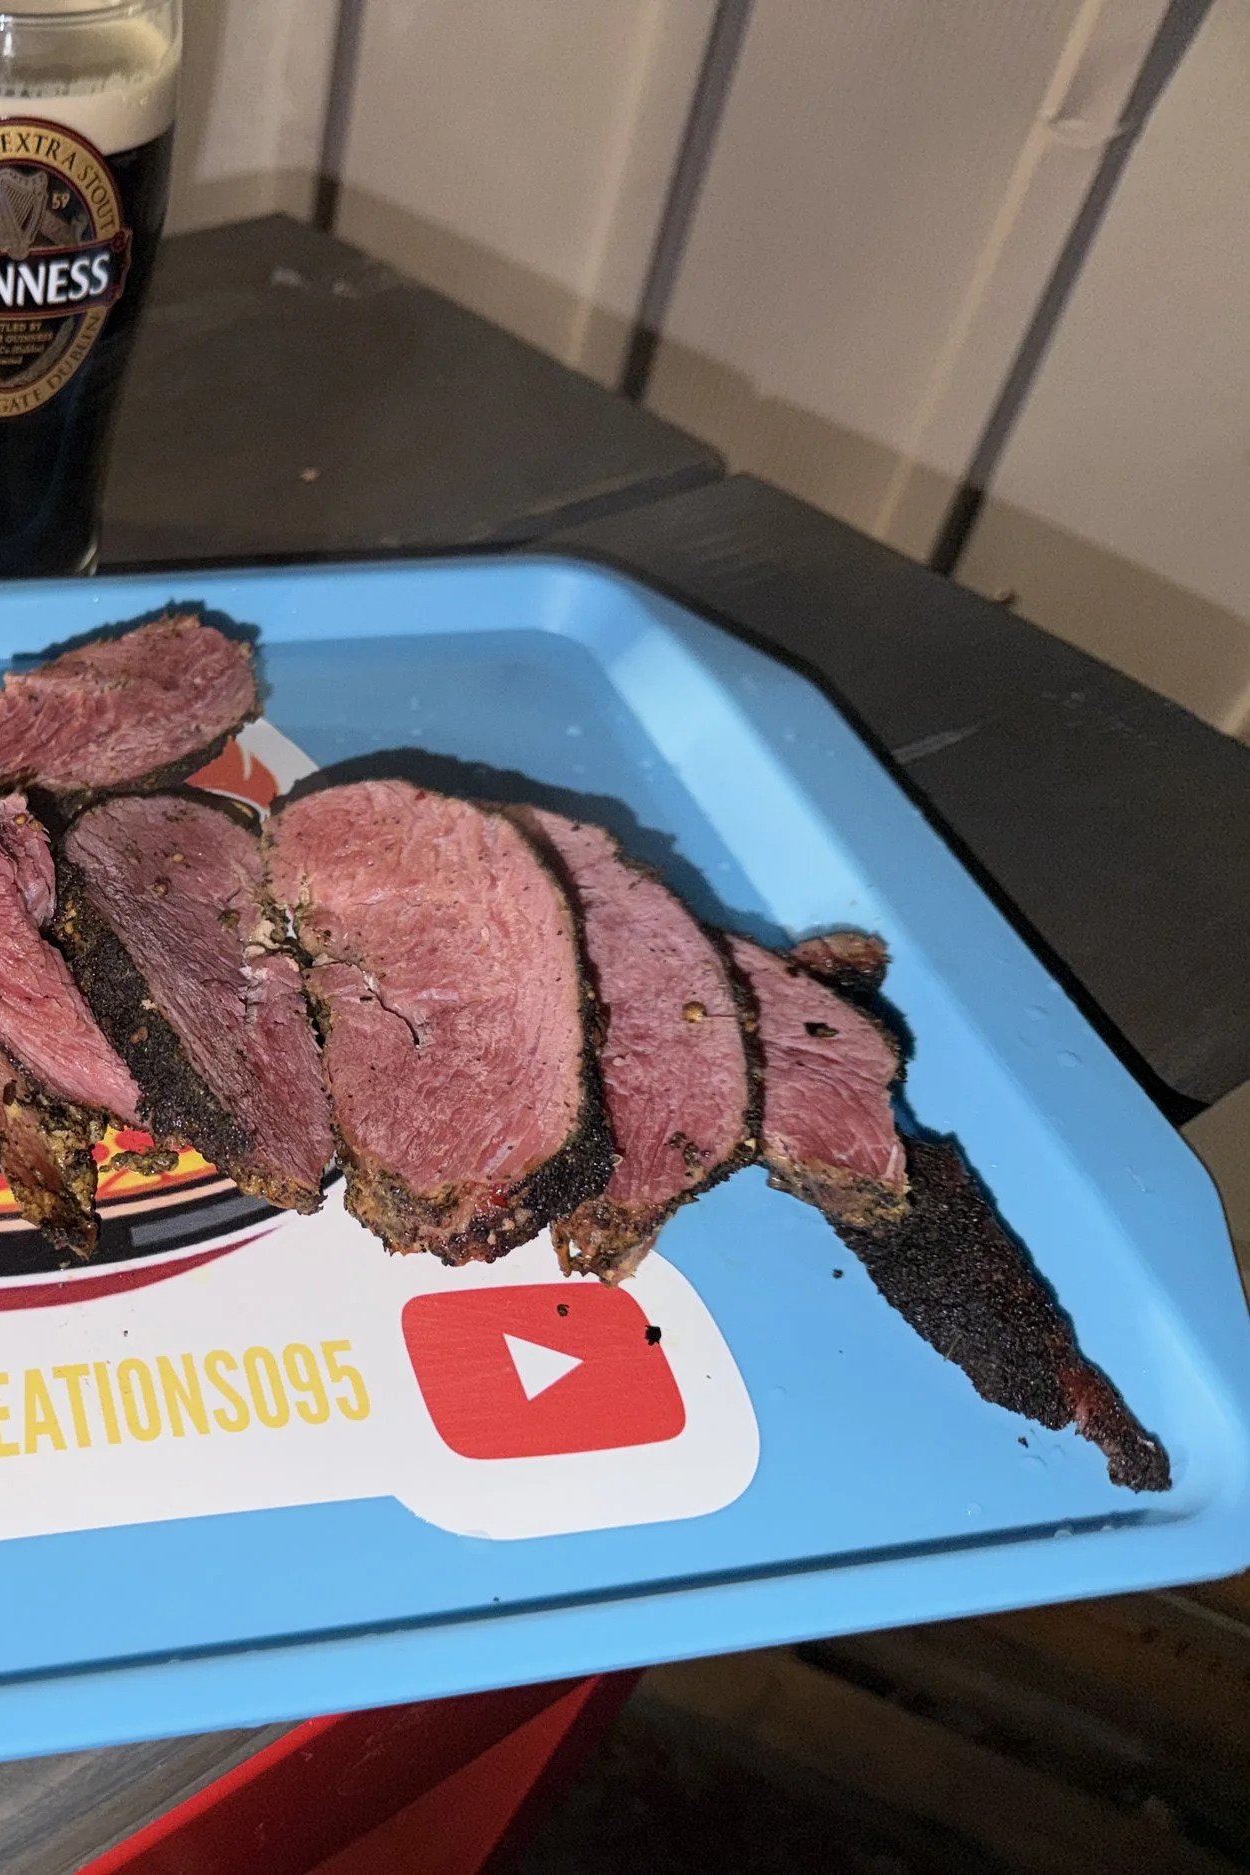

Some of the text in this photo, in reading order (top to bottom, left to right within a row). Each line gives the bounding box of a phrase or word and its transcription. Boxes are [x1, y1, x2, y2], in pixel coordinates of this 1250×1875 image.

[0, 132, 76, 171] EXTRA
[77, 164, 116, 233] STOUT
[52, 192, 71, 210] 59
[46, 314, 101, 391] DUBLIN
